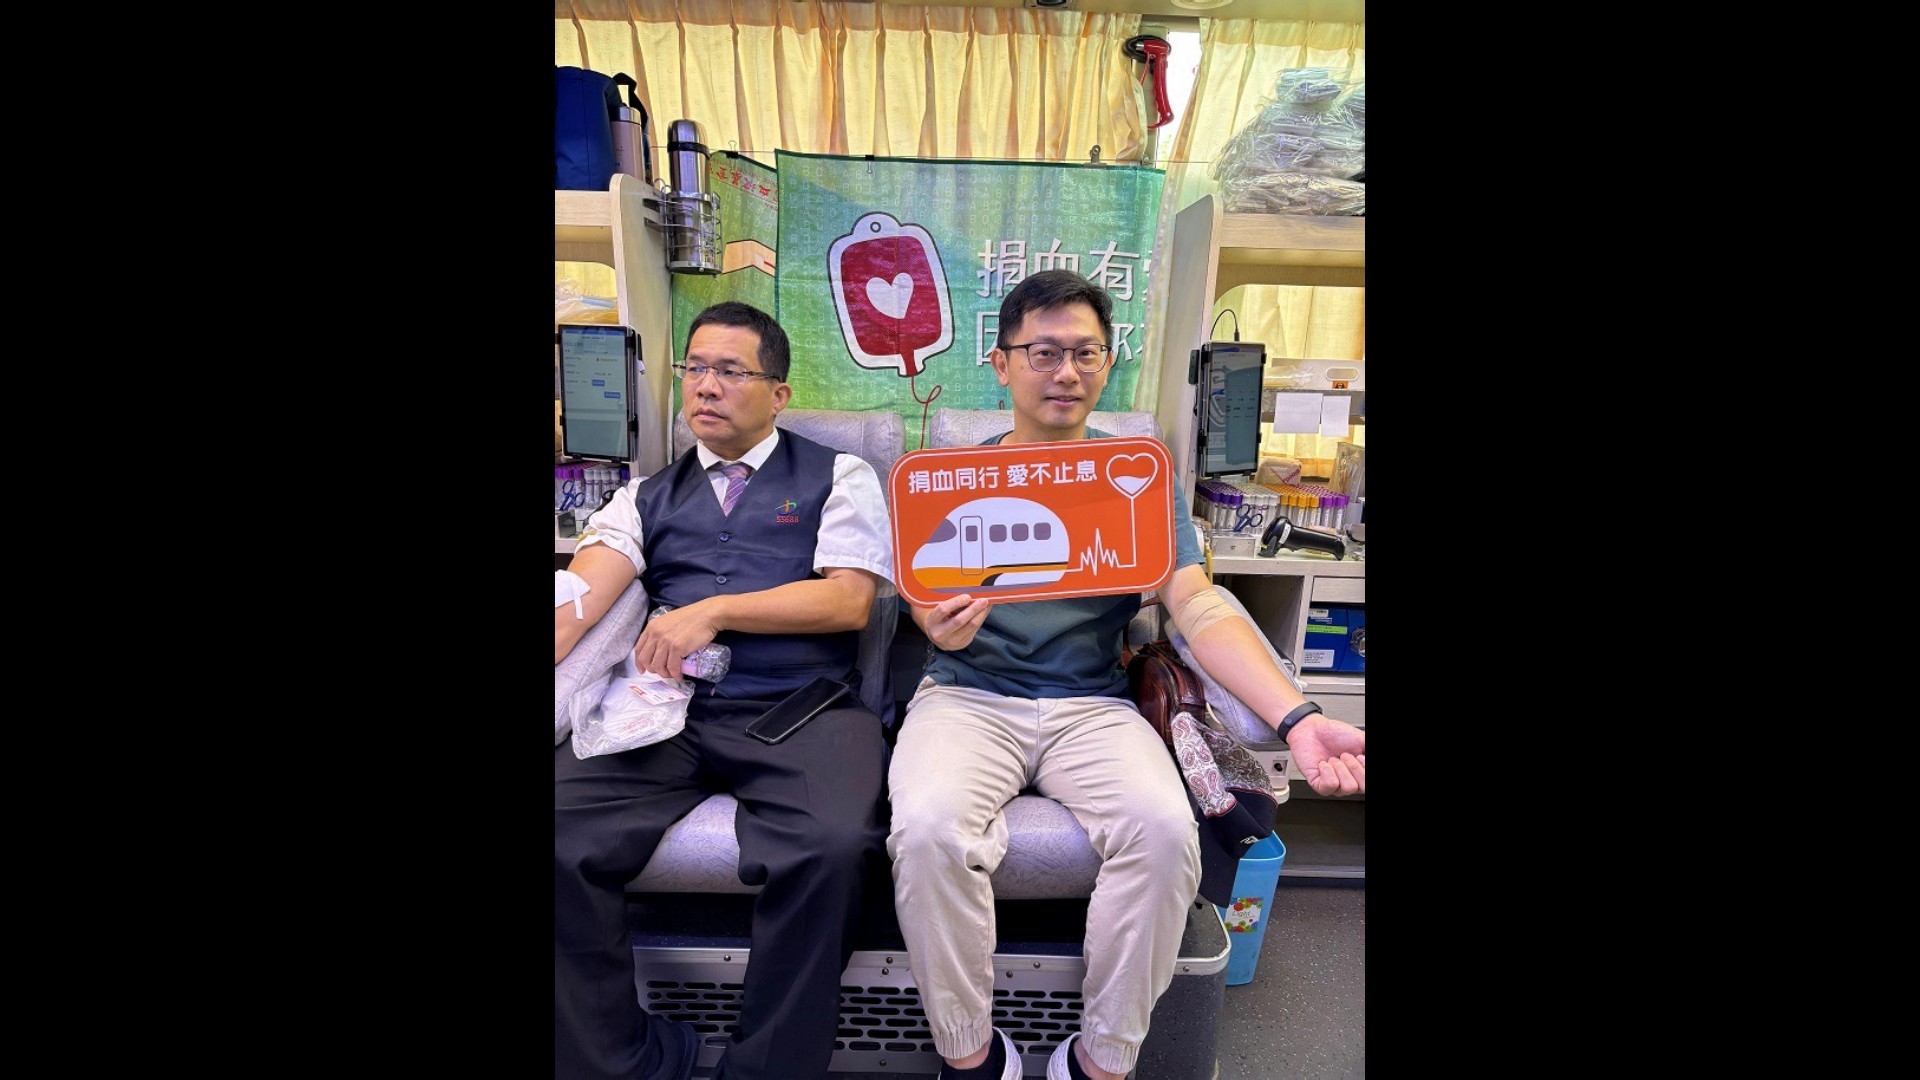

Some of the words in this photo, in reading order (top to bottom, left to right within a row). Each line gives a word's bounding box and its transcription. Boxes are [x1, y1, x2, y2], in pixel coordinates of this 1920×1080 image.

[976, 238, 1153, 301] 捐血有
[908, 466, 1000, 494] 捐血同行
[1006, 460, 1098, 487] 愛不止息
